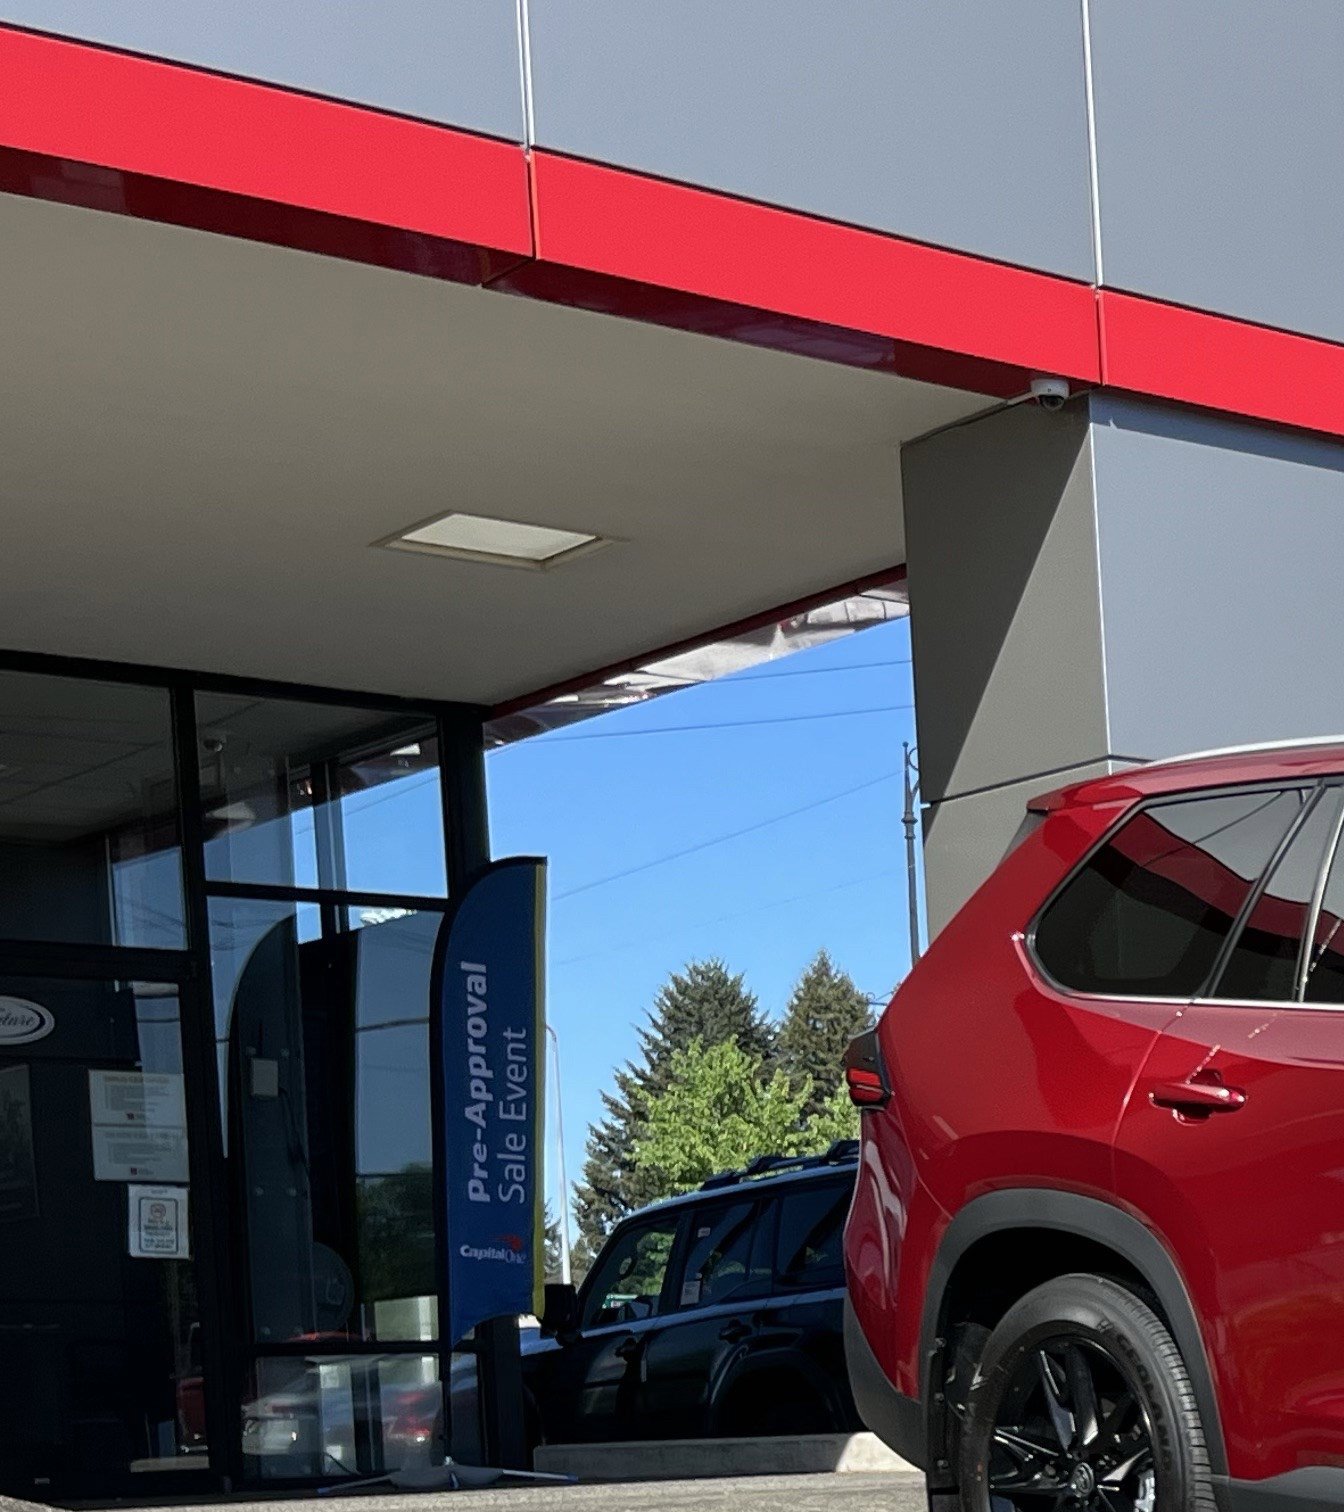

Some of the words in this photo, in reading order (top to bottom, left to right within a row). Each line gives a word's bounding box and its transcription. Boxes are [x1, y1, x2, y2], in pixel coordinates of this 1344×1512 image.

[460, 960, 494, 1203] Pre-Approval
[498, 1026, 527, 1122] Event
[496, 1133, 527, 1204] Sale
